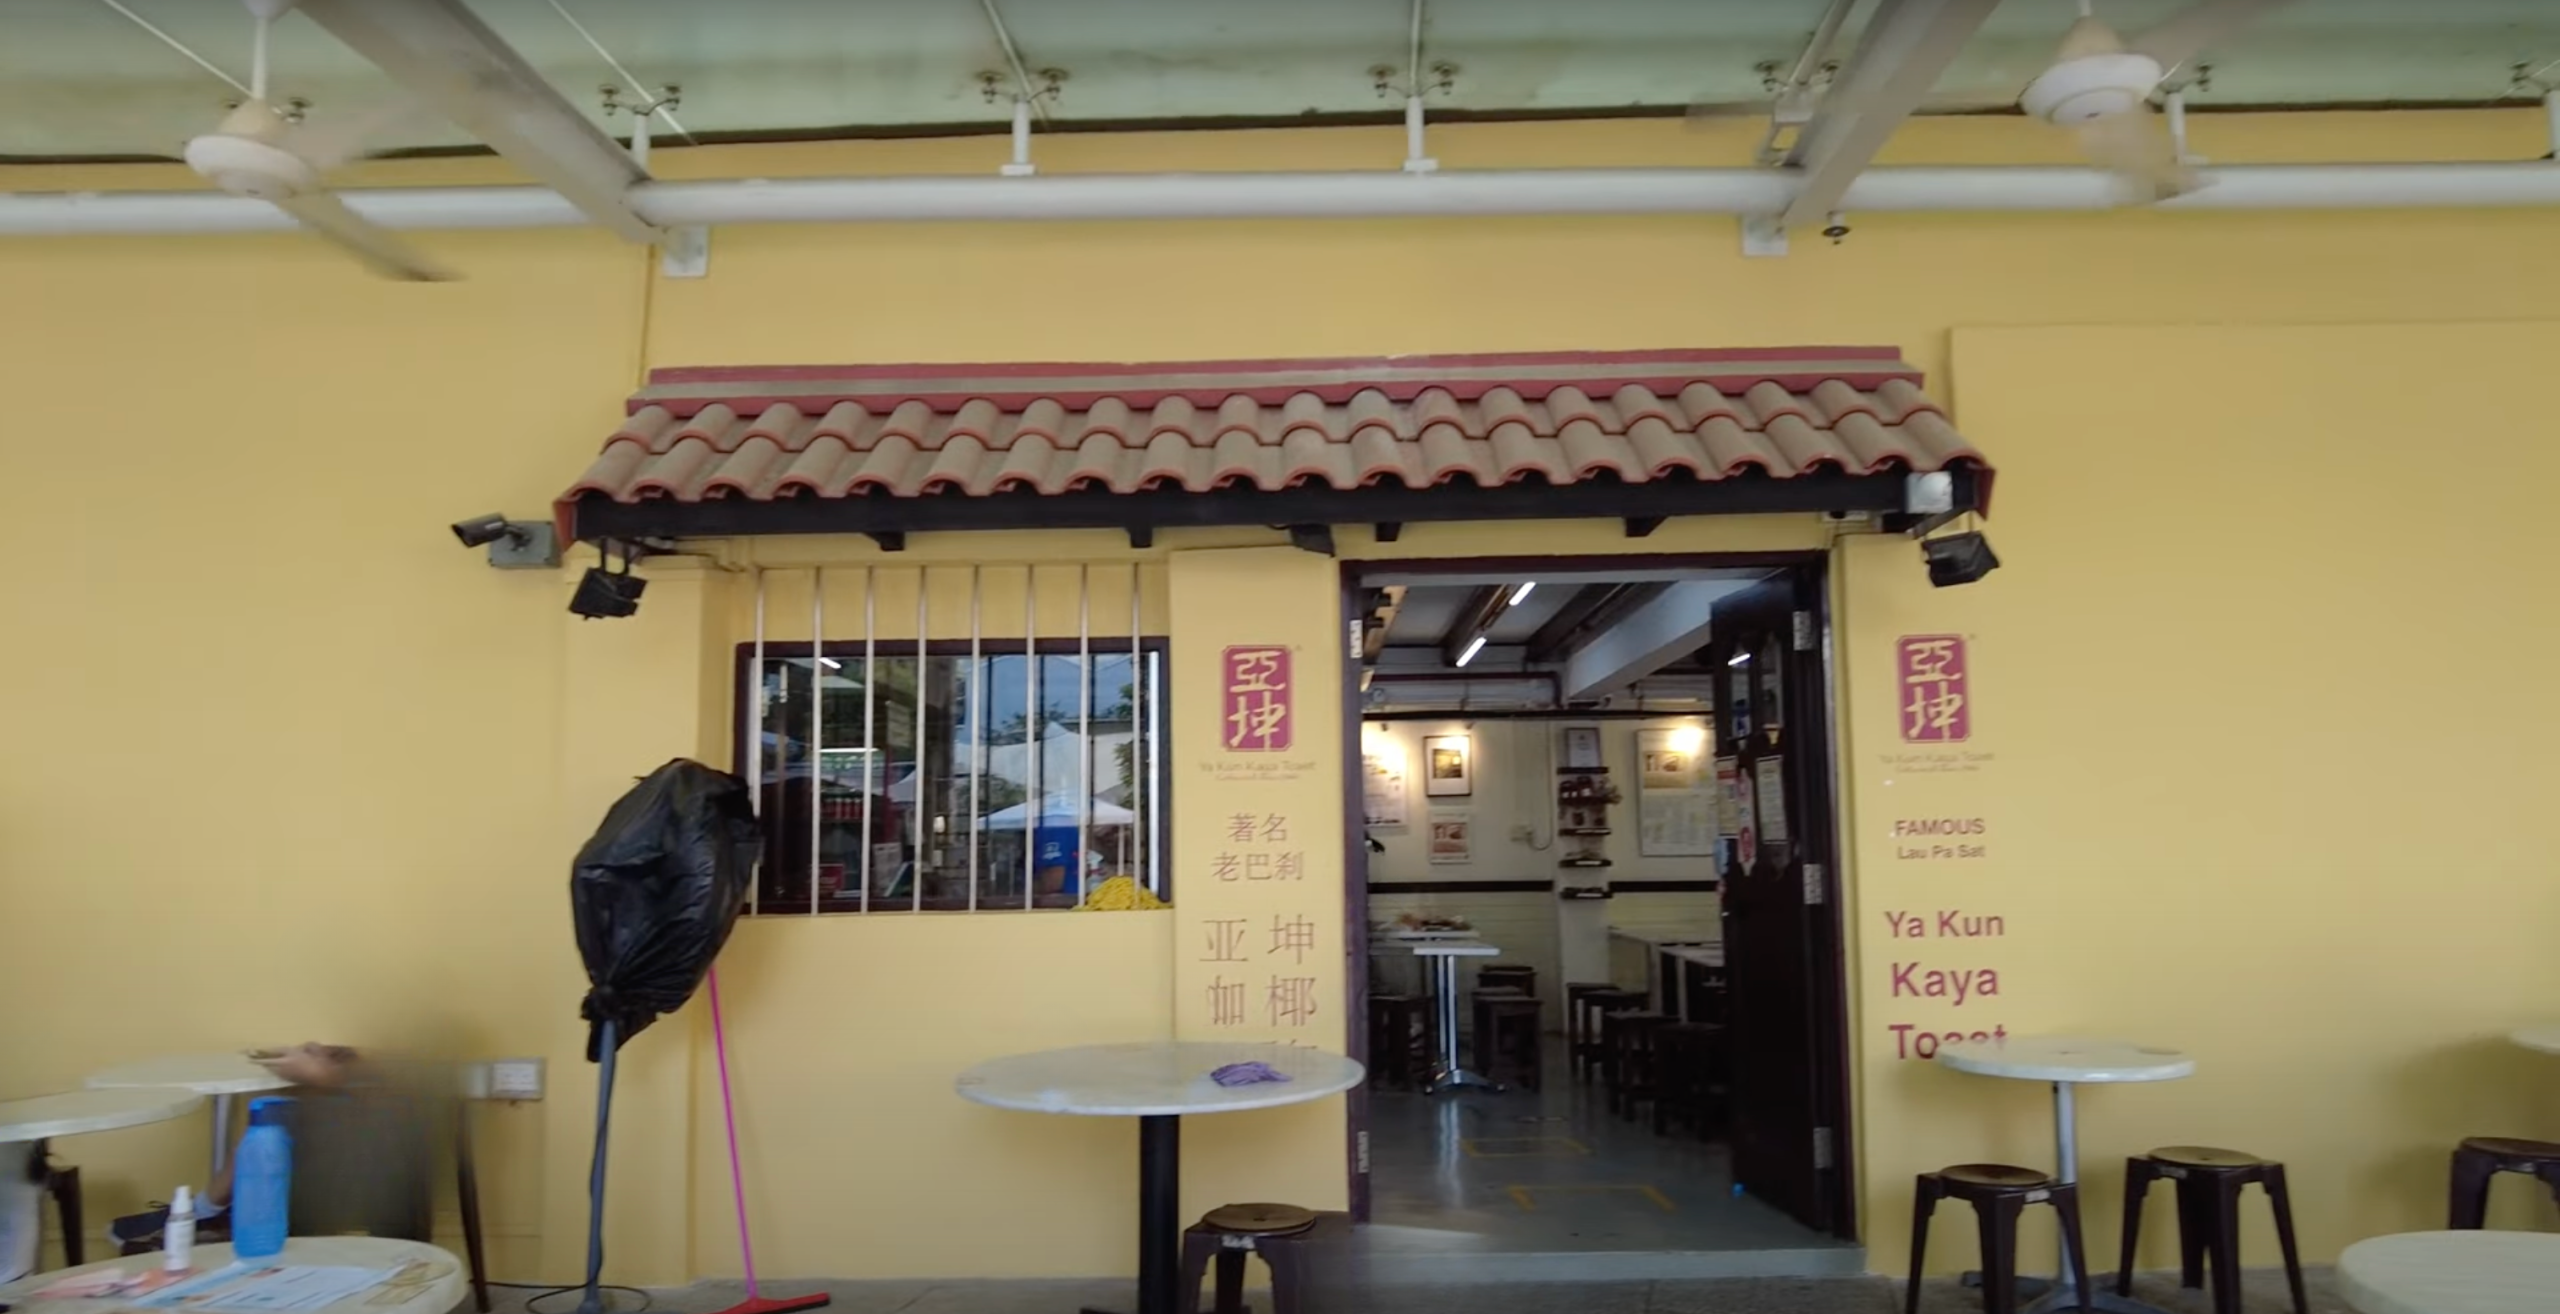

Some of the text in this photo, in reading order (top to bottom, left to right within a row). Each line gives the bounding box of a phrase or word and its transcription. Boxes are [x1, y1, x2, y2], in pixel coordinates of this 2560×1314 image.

[1226, 812, 1287, 843] 著名
[1894, 818, 1986, 836] FAMOUS
[1896, 844, 1986, 860] Lau Pa Sat
[1884, 909, 2005, 938] Ya Kun
[1890, 961, 1999, 1007] Kaya
